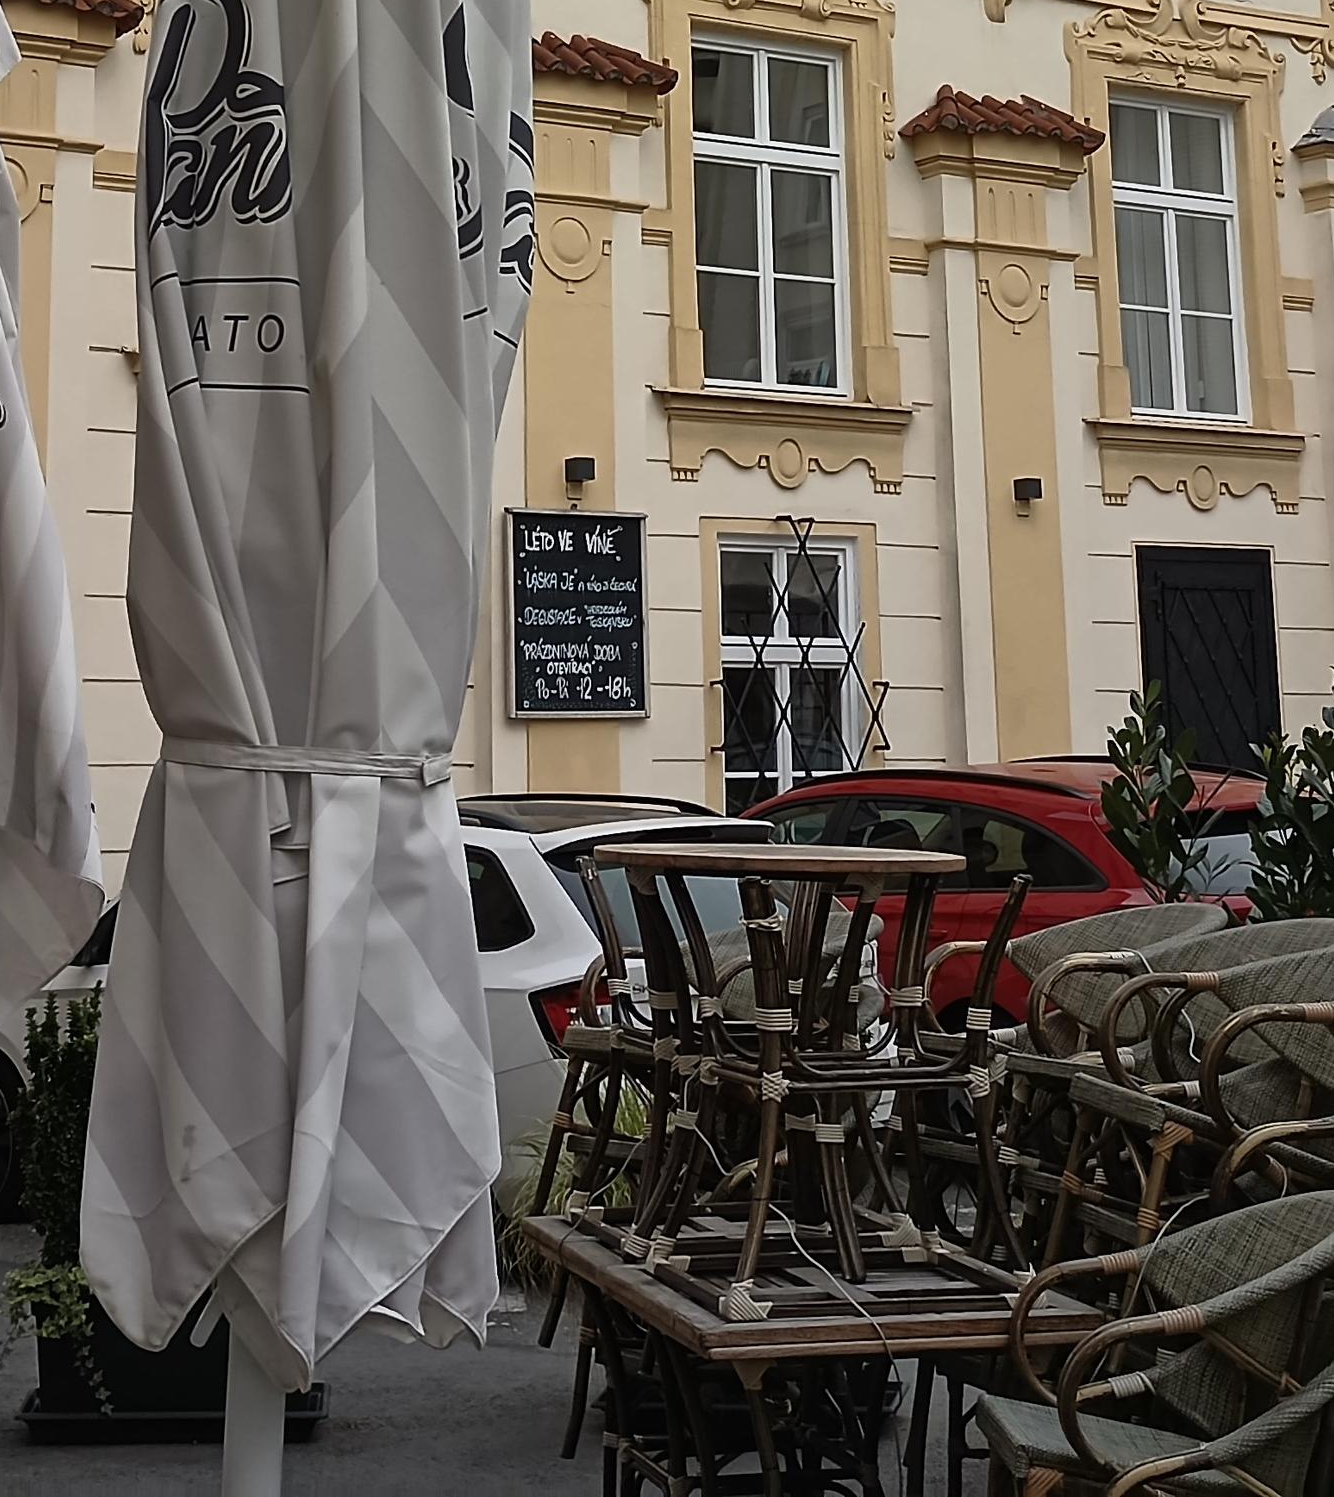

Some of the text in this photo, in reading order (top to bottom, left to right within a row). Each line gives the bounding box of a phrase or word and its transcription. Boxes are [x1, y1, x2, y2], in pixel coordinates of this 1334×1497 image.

[191, 314, 285, 353] ATO
[524, 524, 623, 555] LÉTO VE VÍNĚ
[593, 644, 622, 662] DOBA
